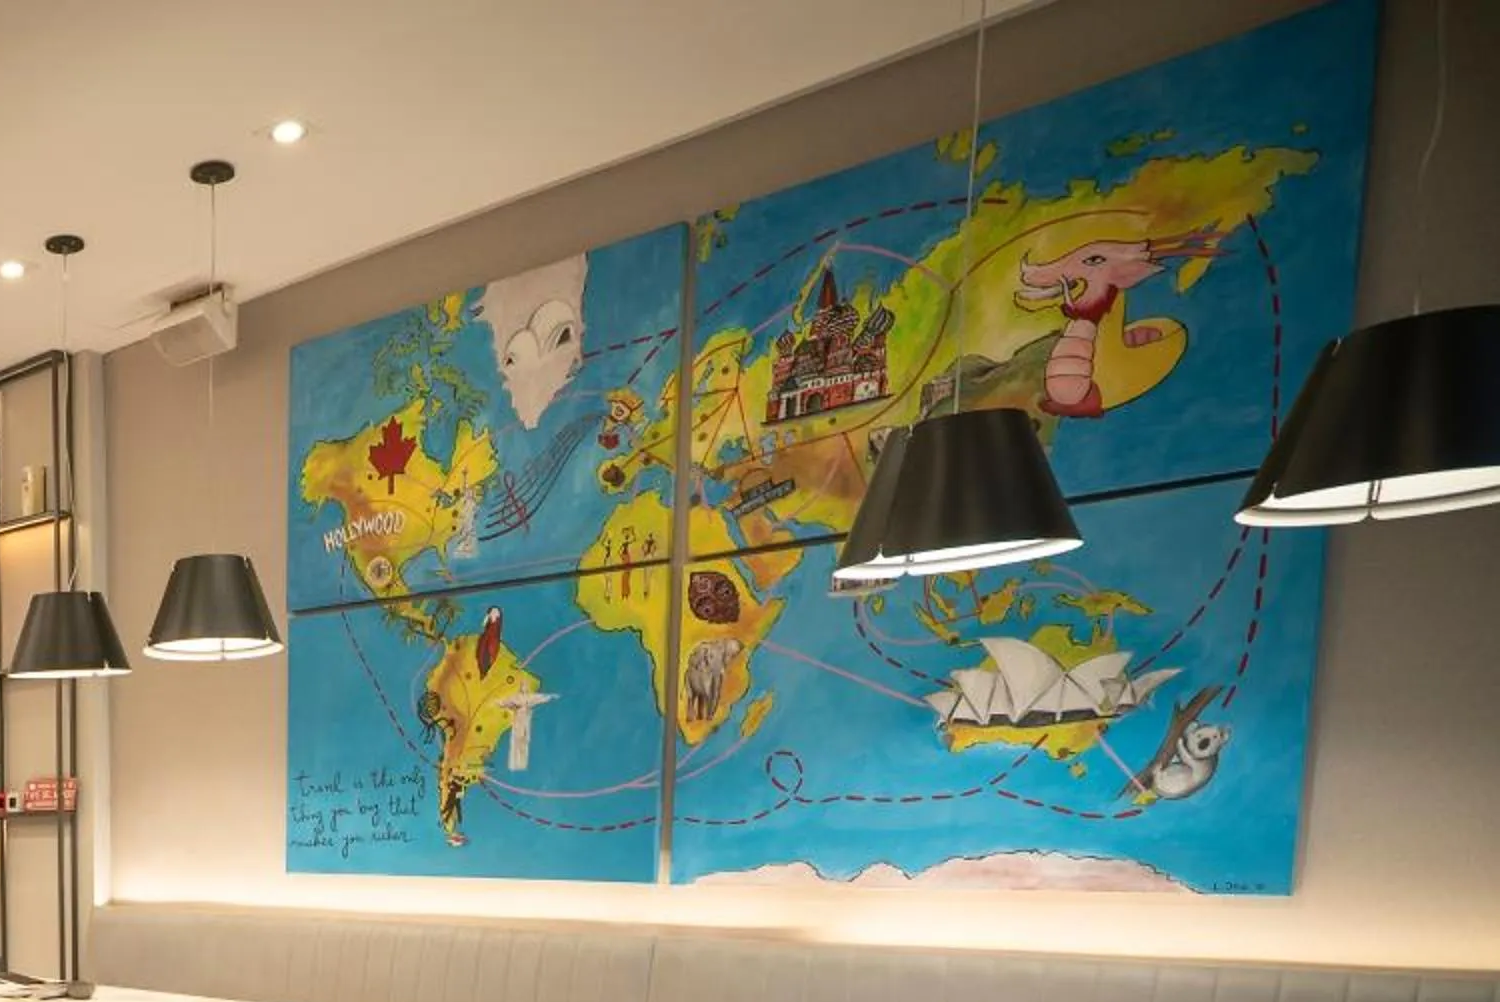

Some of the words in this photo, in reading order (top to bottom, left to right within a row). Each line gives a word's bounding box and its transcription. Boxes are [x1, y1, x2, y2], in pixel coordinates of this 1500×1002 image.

[323, 511, 406, 553] HOLLYWOOD
[369, 767, 396, 790] the
[401, 764, 426, 800] only
[389, 794, 420, 817] that
